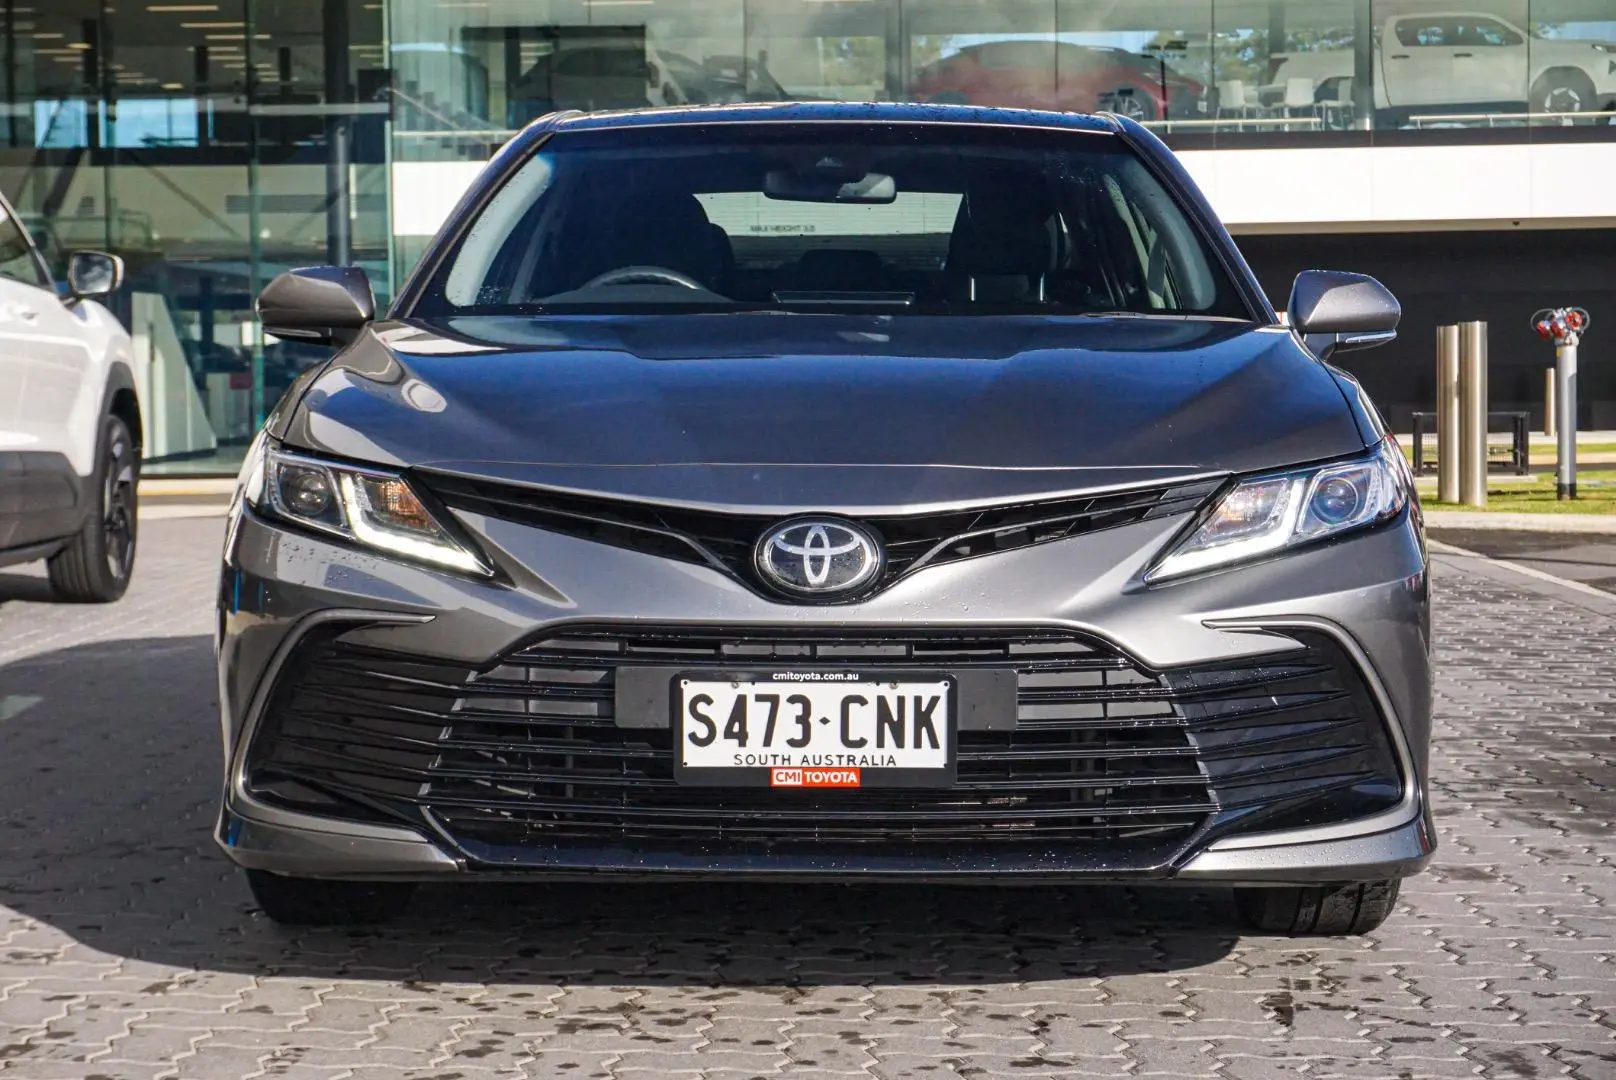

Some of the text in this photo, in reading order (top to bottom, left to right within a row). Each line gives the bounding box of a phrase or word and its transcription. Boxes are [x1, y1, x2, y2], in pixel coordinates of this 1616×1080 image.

[772, 672, 859, 682] cmitoyota.com.au
[734, 753, 897, 767] SOUTH AUSTRALIA
[775, 771, 858, 783] CMI TOYOTA
